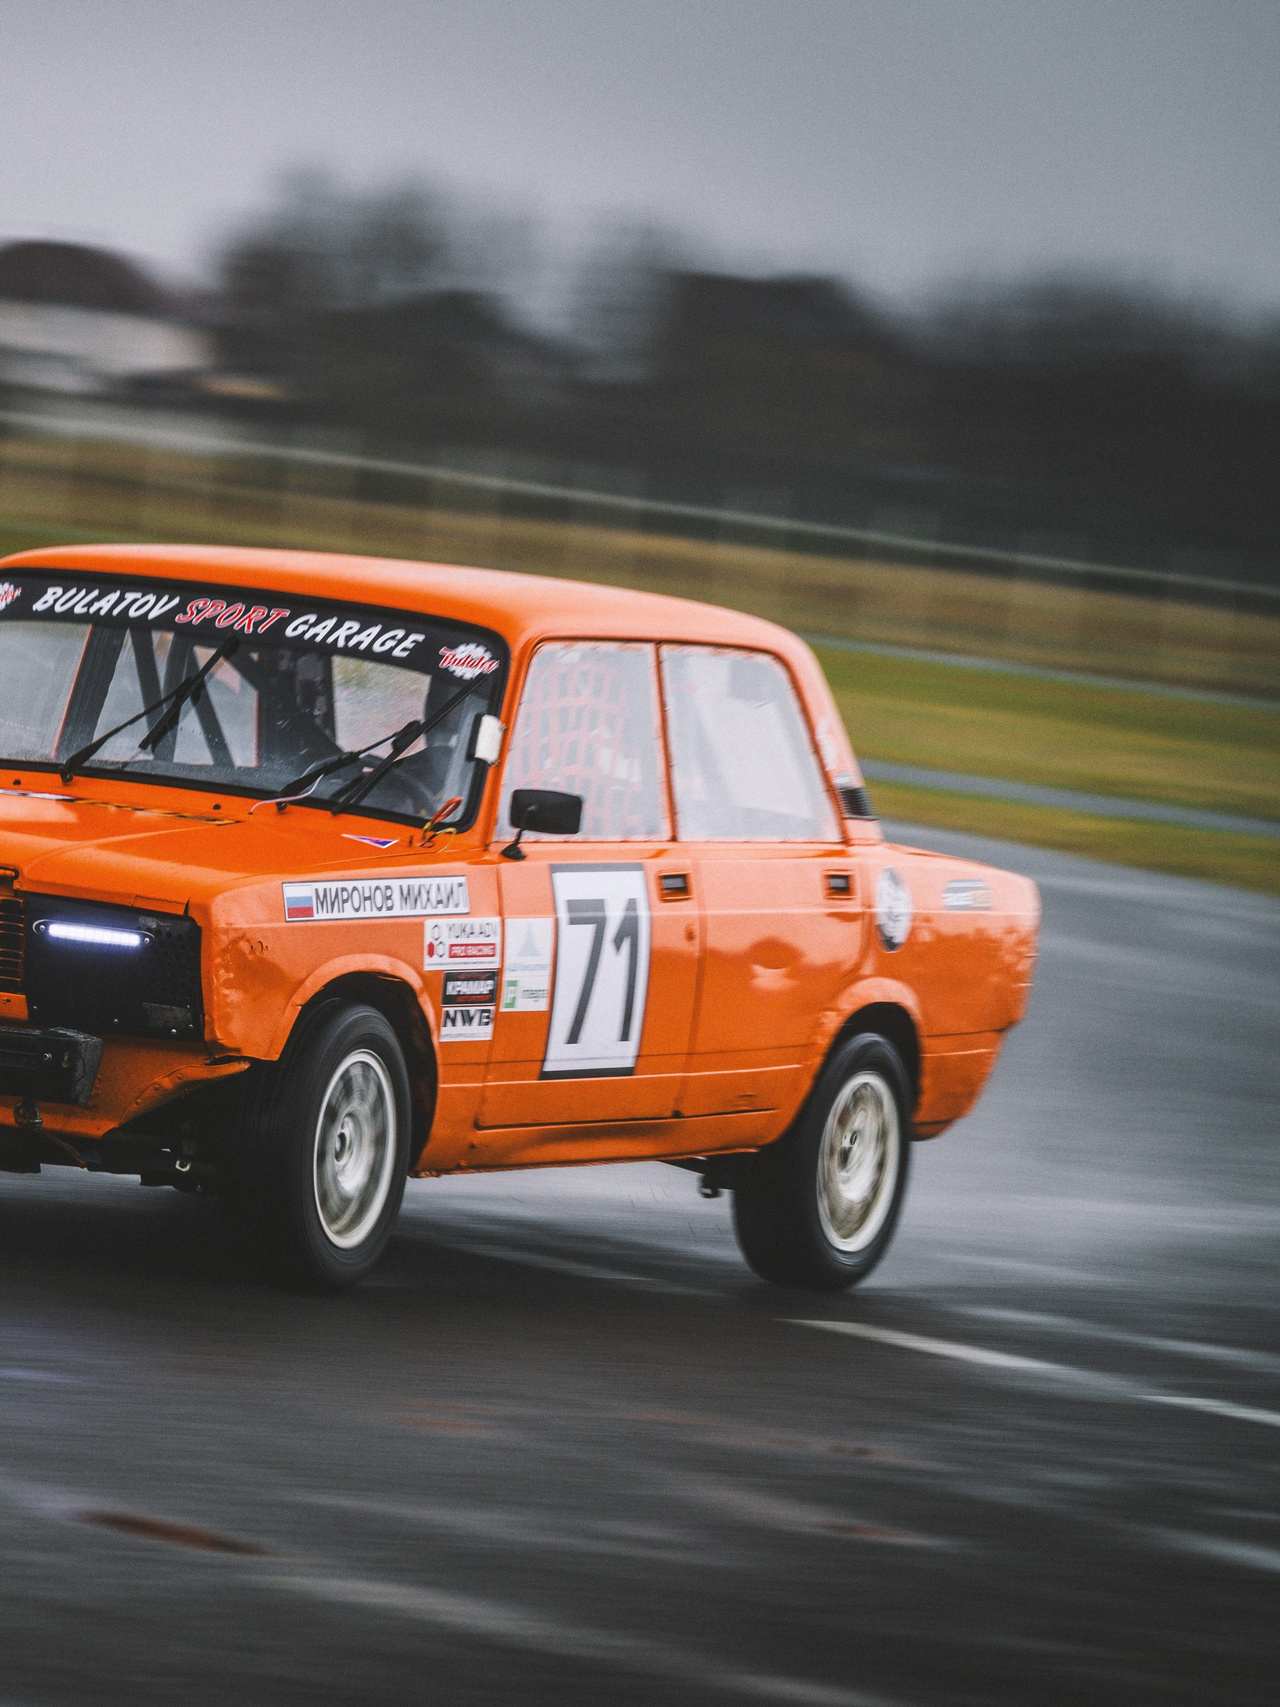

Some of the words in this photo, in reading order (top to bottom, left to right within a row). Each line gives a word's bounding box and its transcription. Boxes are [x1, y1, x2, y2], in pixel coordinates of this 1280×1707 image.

[32, 586, 180, 620] BULATOV
[175, 598, 290, 634] SPORT
[284, 613, 425, 658] GARAGE
[314, 884, 394, 914] МИРОНОВ
[399, 881, 469, 911] МИХАИЛ
[564, 897, 639, 1045] 71
[442, 1008, 493, 1028] NWB
